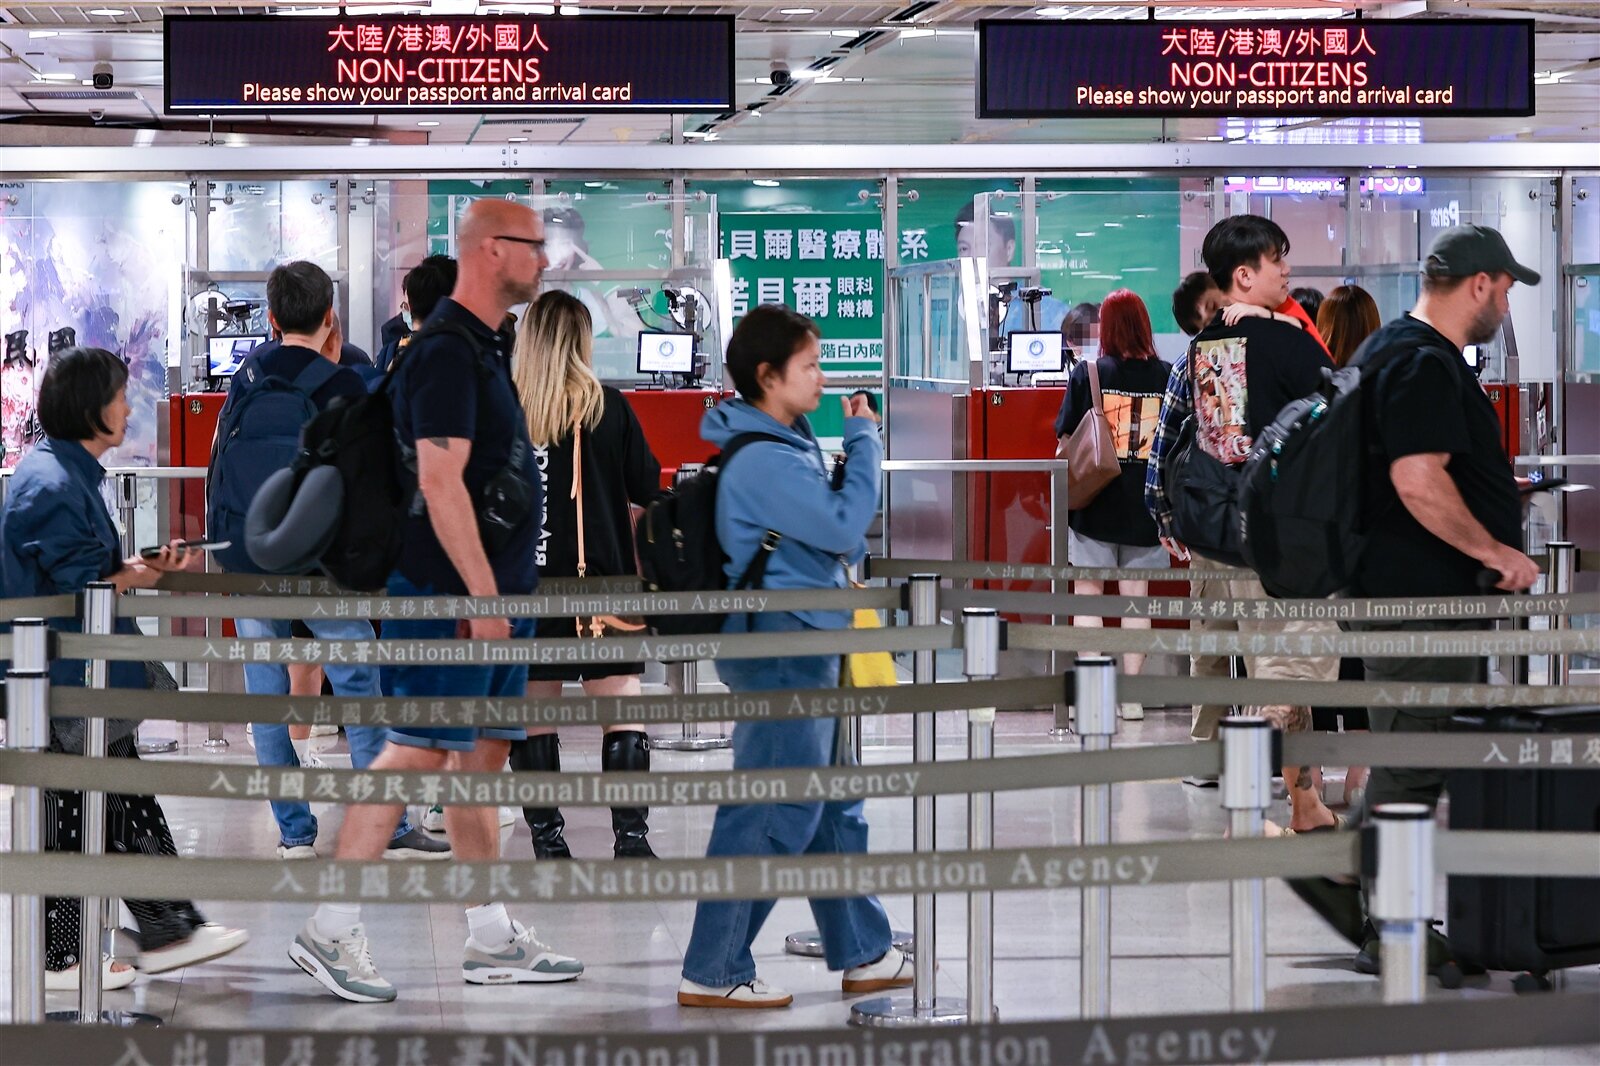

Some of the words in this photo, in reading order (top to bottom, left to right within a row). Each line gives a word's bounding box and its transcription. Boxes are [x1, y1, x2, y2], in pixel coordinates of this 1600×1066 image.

[327, 25, 549, 53] 大陸/港澳/外國人
[1162, 28, 1376, 56] 大陸/港澳/外國人
[337, 58, 540, 85] NON-CITIZENS
[1170, 62, 1368, 87] NON-CITIZENS
[243, 84, 301, 101] Please
[306, 84, 354, 101] show
[360, 86, 402, 105] your
[408, 85, 487, 105] passport
[491, 84, 525, 101] and
[531, 83, 586, 101] arrival
[593, 83, 631, 101] card
[1077, 87, 1134, 105] Please
[1138, 87, 1185, 105] show
[1191, 91, 1230, 108] your
[1236, 88, 1314, 108] passport
[1318, 87, 1350, 104] and
[1356, 87, 1410, 104] arrival
[1415, 87, 1453, 104] card
[721, 229, 929, 260] 貝爾醫療體系
[837, 277, 873, 296] 眼科
[837, 299, 874, 318] 機構
[311, 600, 461, 618] 入出國及移民署
[464, 597, 550, 615] National
[562, 595, 680, 614] Immigration
[691, 594, 768, 611] Agency
[1125, 600, 1269, 618] 入出國及移民署
[1273, 600, 1356, 618] National
[1366, 598, 1487, 617] Immigration
[1497, 598, 1569, 613] Agency
[202, 641, 372, 662] 入出國及移民署
[376, 642, 473, 662] National
[483, 640, 625, 662] Immigration
[637, 639, 721, 658] Agency
[282, 702, 480, 724] 入出國及移民署
[485, 702, 597, 722] National
[615, 697, 771, 722] Immigration
[788, 694, 890, 713] Agency
[210, 771, 445, 801] 入出國及移民署
[450, 776, 583, 801] National
[593, 774, 788, 803] Immigration
[804, 771, 922, 799] Agency
[272, 863, 562, 899] 入出國及移民署
[569, 862, 734, 895] National
[760, 858, 986, 894] Immigration
[1010, 852, 1160, 884] Agency
[1082, 1023, 1276, 1060] Agency
